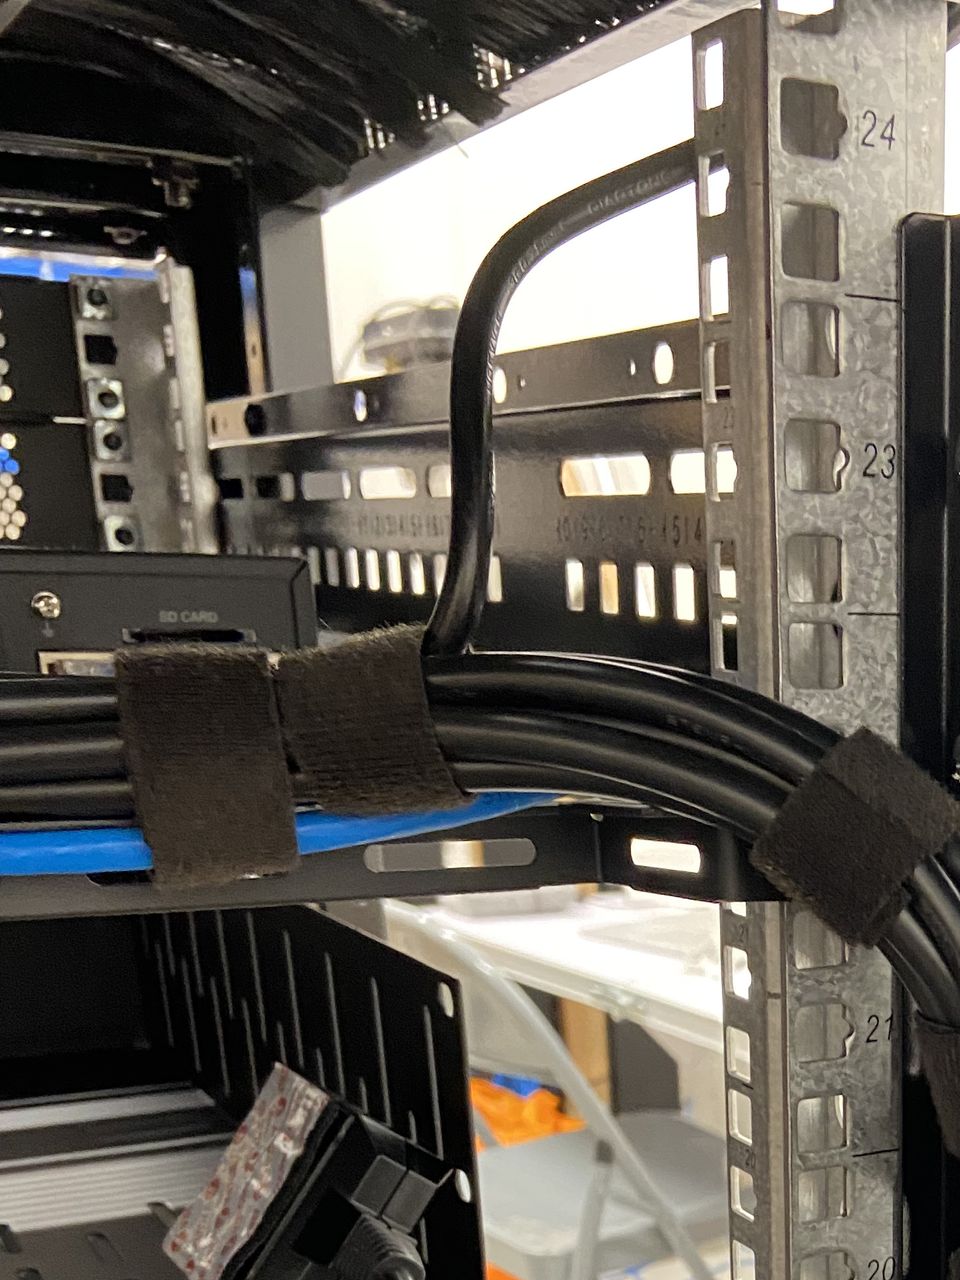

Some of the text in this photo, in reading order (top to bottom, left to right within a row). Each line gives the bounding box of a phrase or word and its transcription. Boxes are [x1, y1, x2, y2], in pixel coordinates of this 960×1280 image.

[860, 109, 896, 152] 24
[862, 442, 896, 480] 23
[865, 1009, 894, 1044] 21
